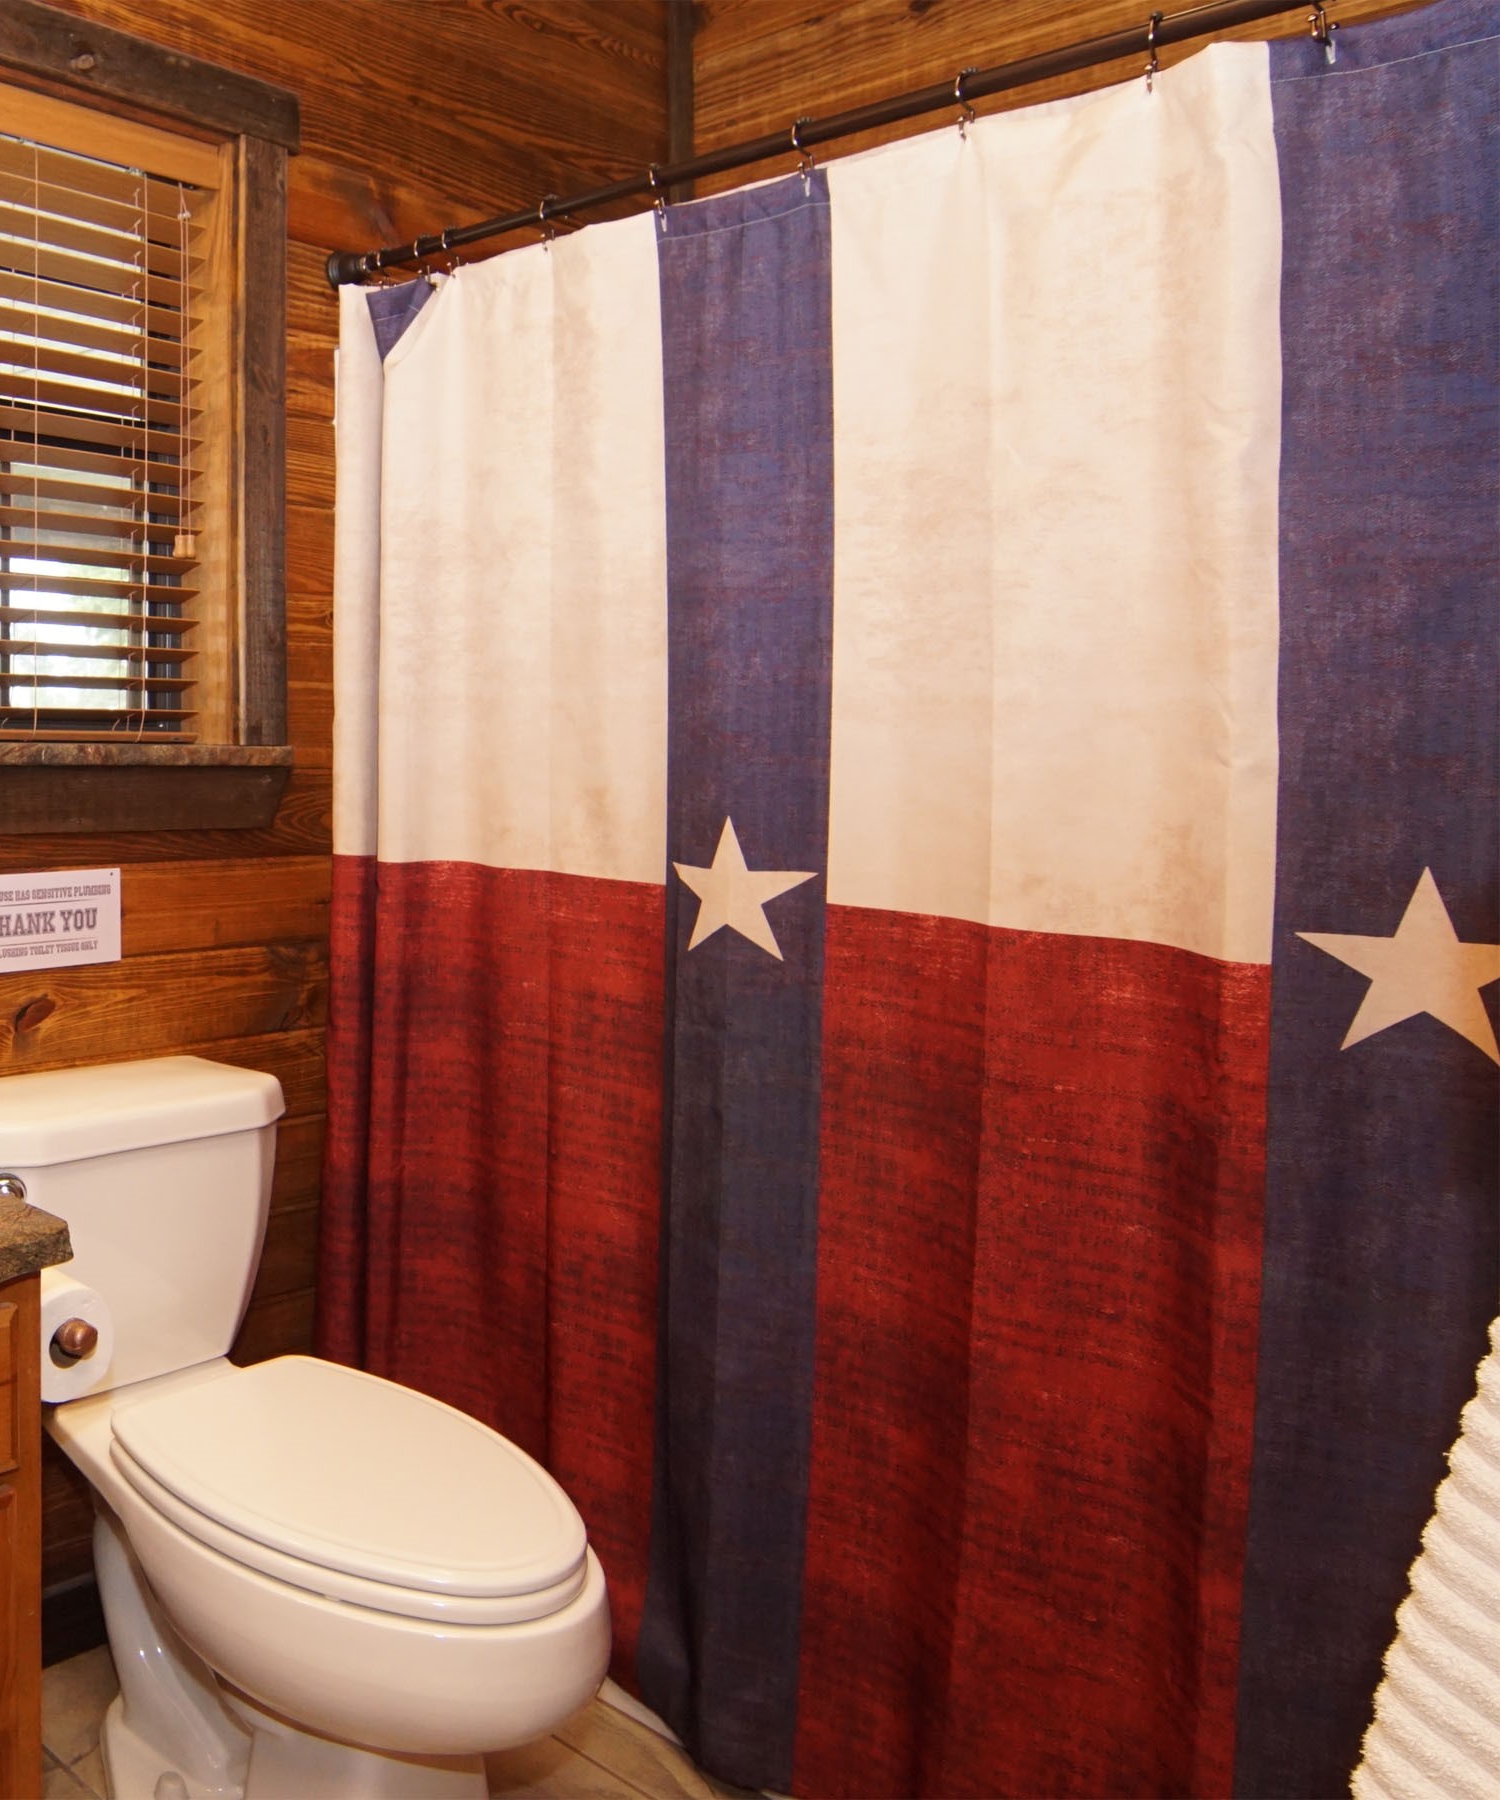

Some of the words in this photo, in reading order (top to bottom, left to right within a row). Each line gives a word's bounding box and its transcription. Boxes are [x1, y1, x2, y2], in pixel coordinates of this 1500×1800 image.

[32, 887, 72, 900] SENSITIVE
[60, 908, 97, 931] YOU
[30, 944, 54, 956] TOILET
[81, 940, 98, 951] ONLY
